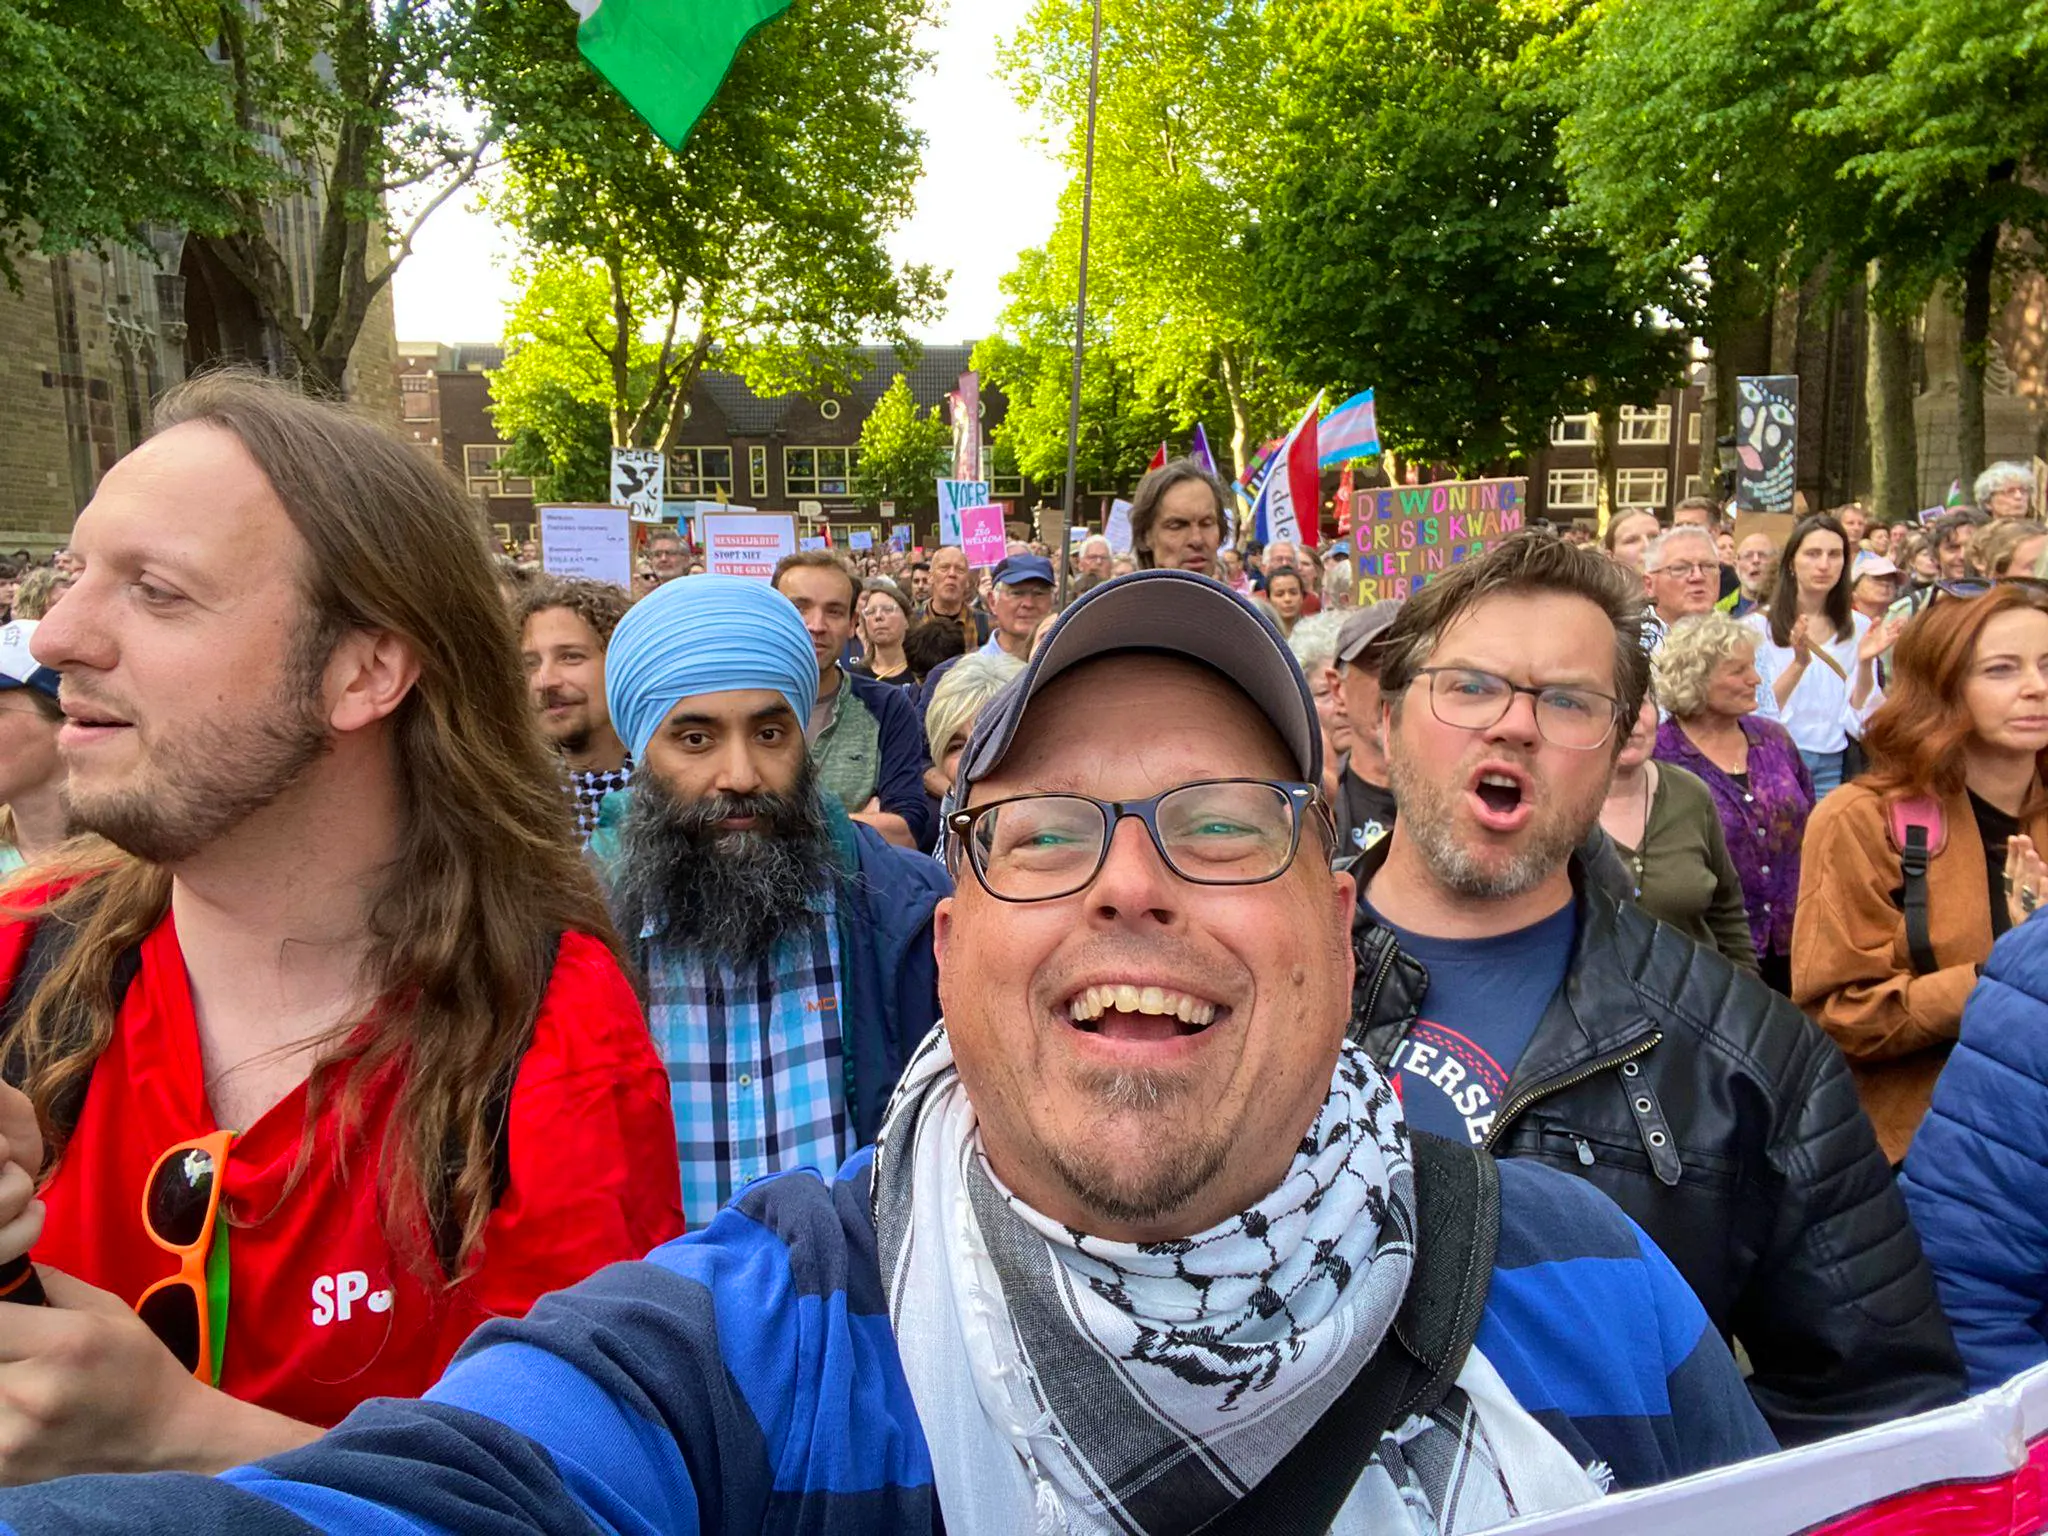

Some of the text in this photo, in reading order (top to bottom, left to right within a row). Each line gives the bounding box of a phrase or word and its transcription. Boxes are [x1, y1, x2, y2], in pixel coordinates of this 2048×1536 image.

[617, 450, 659, 464] PEACE
[945, 482, 987, 510] VOER
[1358, 482, 1524, 521] DE WONING-
[1356, 508, 1520, 552] CRISIS KWAM
[714, 551, 761, 560] STOPT NIET
[1359, 551, 1410, 576] NIET
[1419, 548, 1444, 571] IN
